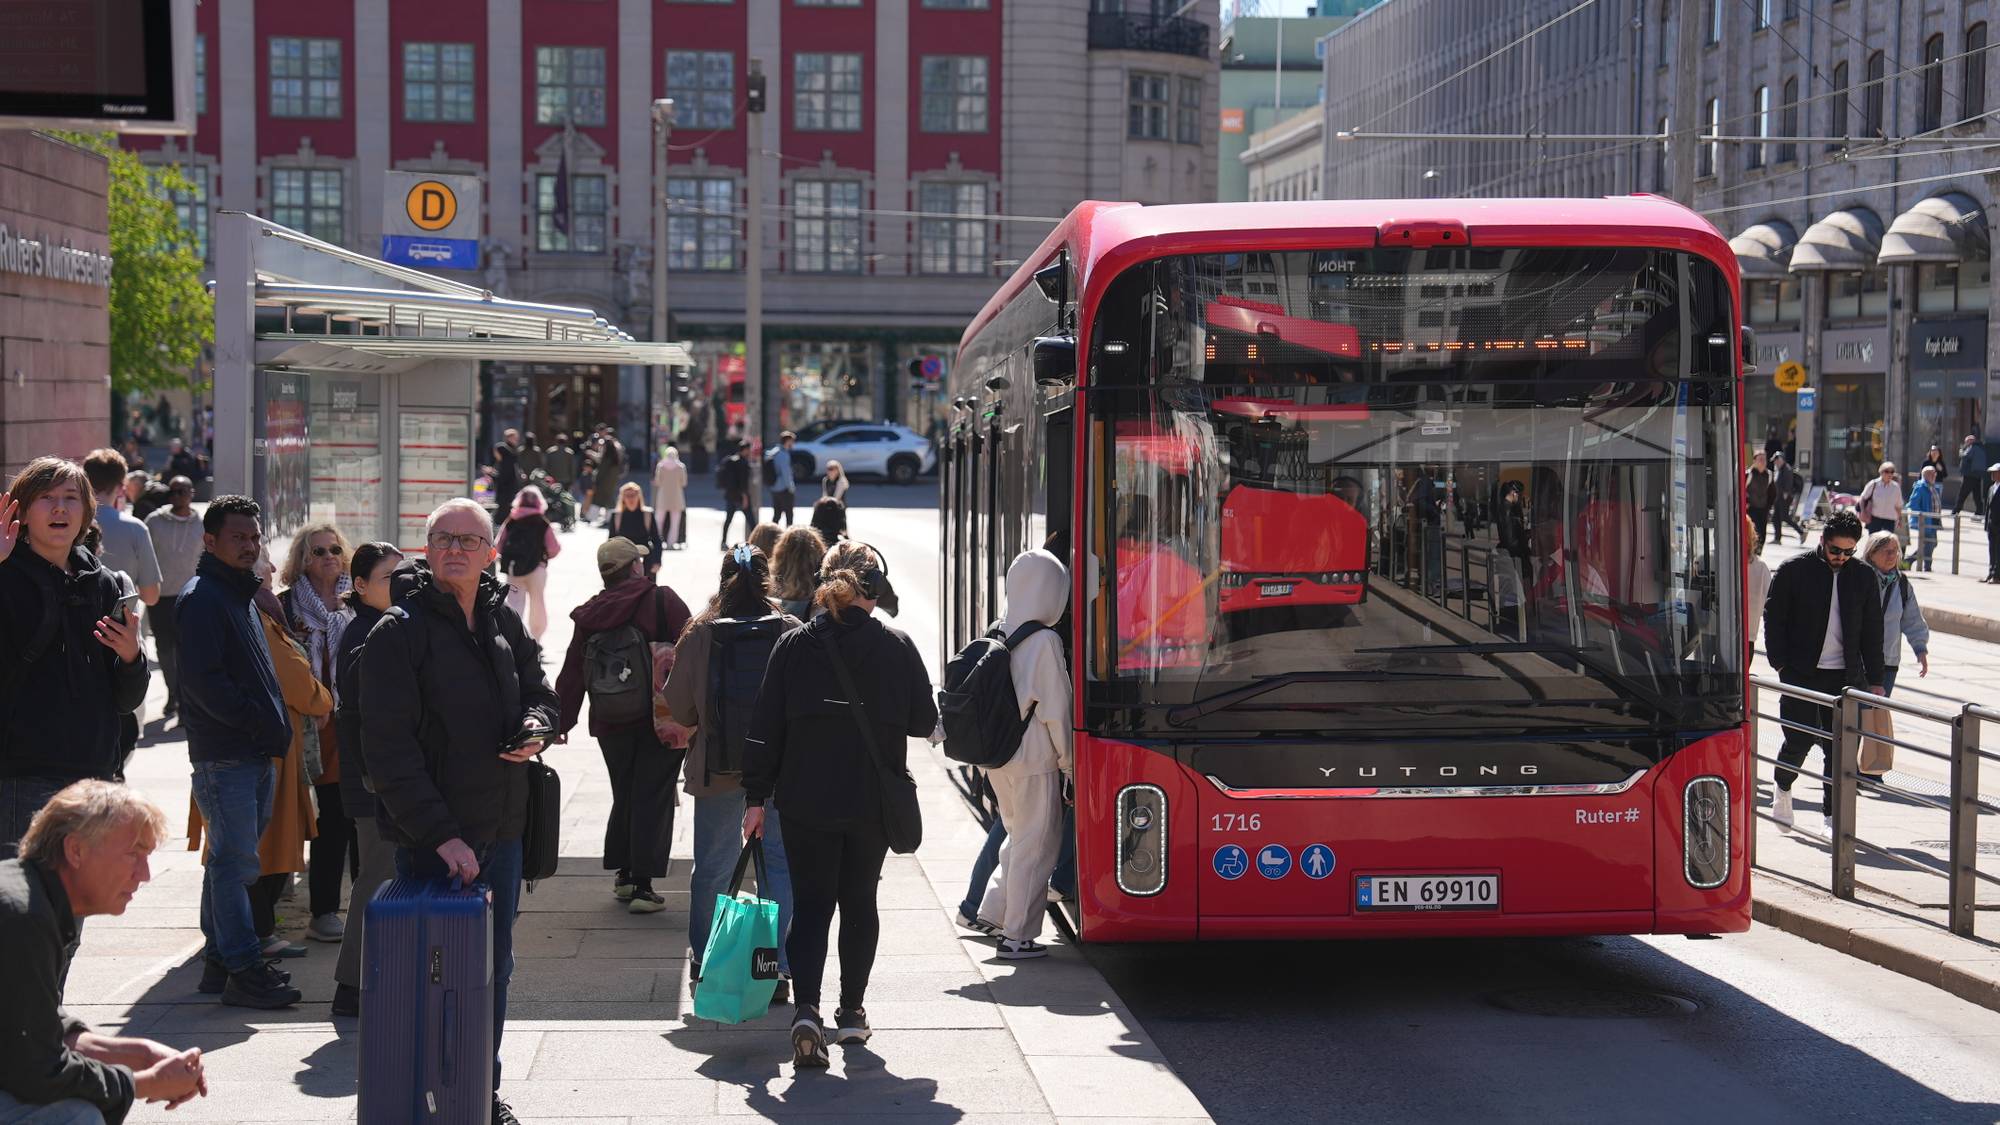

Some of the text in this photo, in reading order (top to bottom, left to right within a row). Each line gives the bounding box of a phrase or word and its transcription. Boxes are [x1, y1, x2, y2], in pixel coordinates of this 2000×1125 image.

[422, 189, 445, 221] D
[1319, 765, 1538, 777] YUTONG
[1211, 813, 1261, 832] 1716
[1378, 880, 1491, 902] EN 69910
